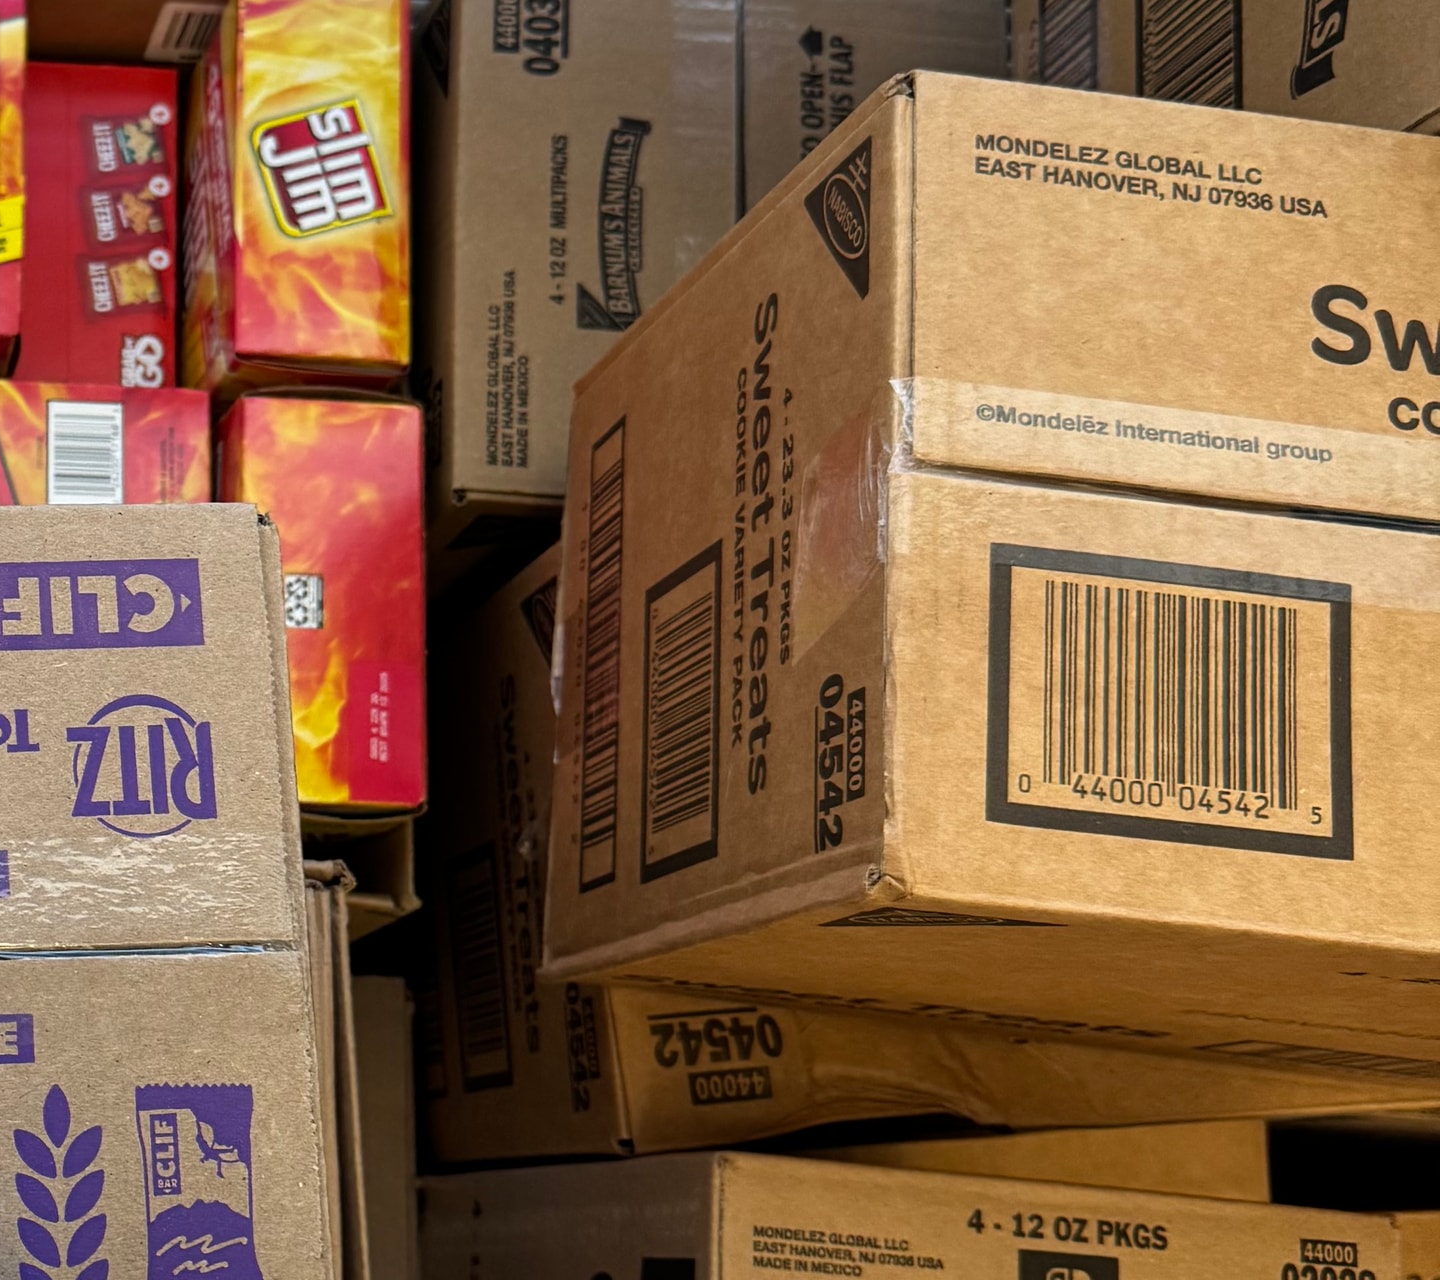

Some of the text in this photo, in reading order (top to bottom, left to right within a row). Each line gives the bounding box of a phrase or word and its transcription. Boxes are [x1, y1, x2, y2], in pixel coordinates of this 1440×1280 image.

[550, 133, 569, 230] MULTIPACKS
[600, 131, 636, 218] ANIMALS
[974, 133, 1263, 186] MONDELEZ GLOBAL LLC
[974, 156, 1329, 219] EAST HANOVER, NJ 07936 USA
[827, 186, 863, 248] NABISCO
[486, 334, 500, 467] MONDELEZ GLOBAL
[517, 353, 530, 409] MEXICO
[1115, 419, 1333, 465] International group
[730, 367, 748, 748] COOKIE VARIETY PACK
[747, 292, 779, 797] Sweet Treats
[778, 433, 795, 666] 23.3 PKGS
[1, 574, 176, 637] CLIF
[66, 720, 218, 820] RITZ
[818, 672, 845, 853] 04542
[847, 697, 864, 793] 44000
[1071, 773, 1270, 820] 44000 04542
[650, 1013, 784, 1067] 04542
[694, 1070, 768, 1099] 44000
[753, 1225, 910, 1252] MONDELEZ GLOBAL LLC
[753, 1240, 944, 1270] EAST HANOVER, 07936 USA
[967, 1208, 1169, 1251] 4 12 OZ PKGS
[1303, 1241, 1355, 1265] 44000
[753, 1256, 863, 1278] MADE MEXICO
